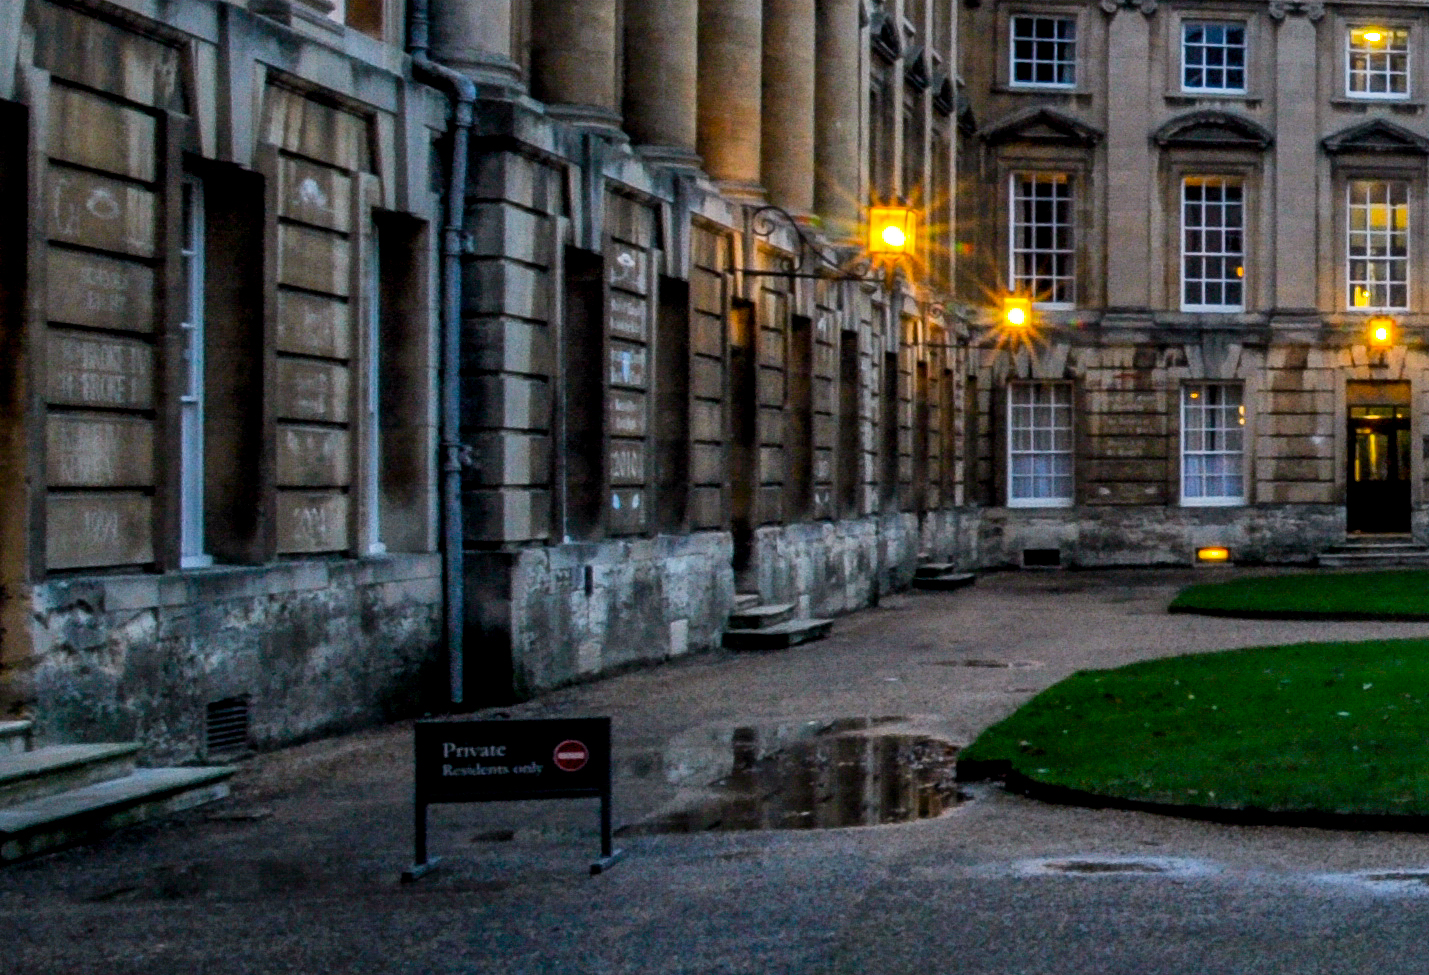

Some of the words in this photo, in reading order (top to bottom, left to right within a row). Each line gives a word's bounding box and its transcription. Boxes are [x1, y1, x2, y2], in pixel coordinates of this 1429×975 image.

[442, 742, 507, 758] Private
[442, 763, 510, 776] Residents
[513, 761, 543, 776] only
